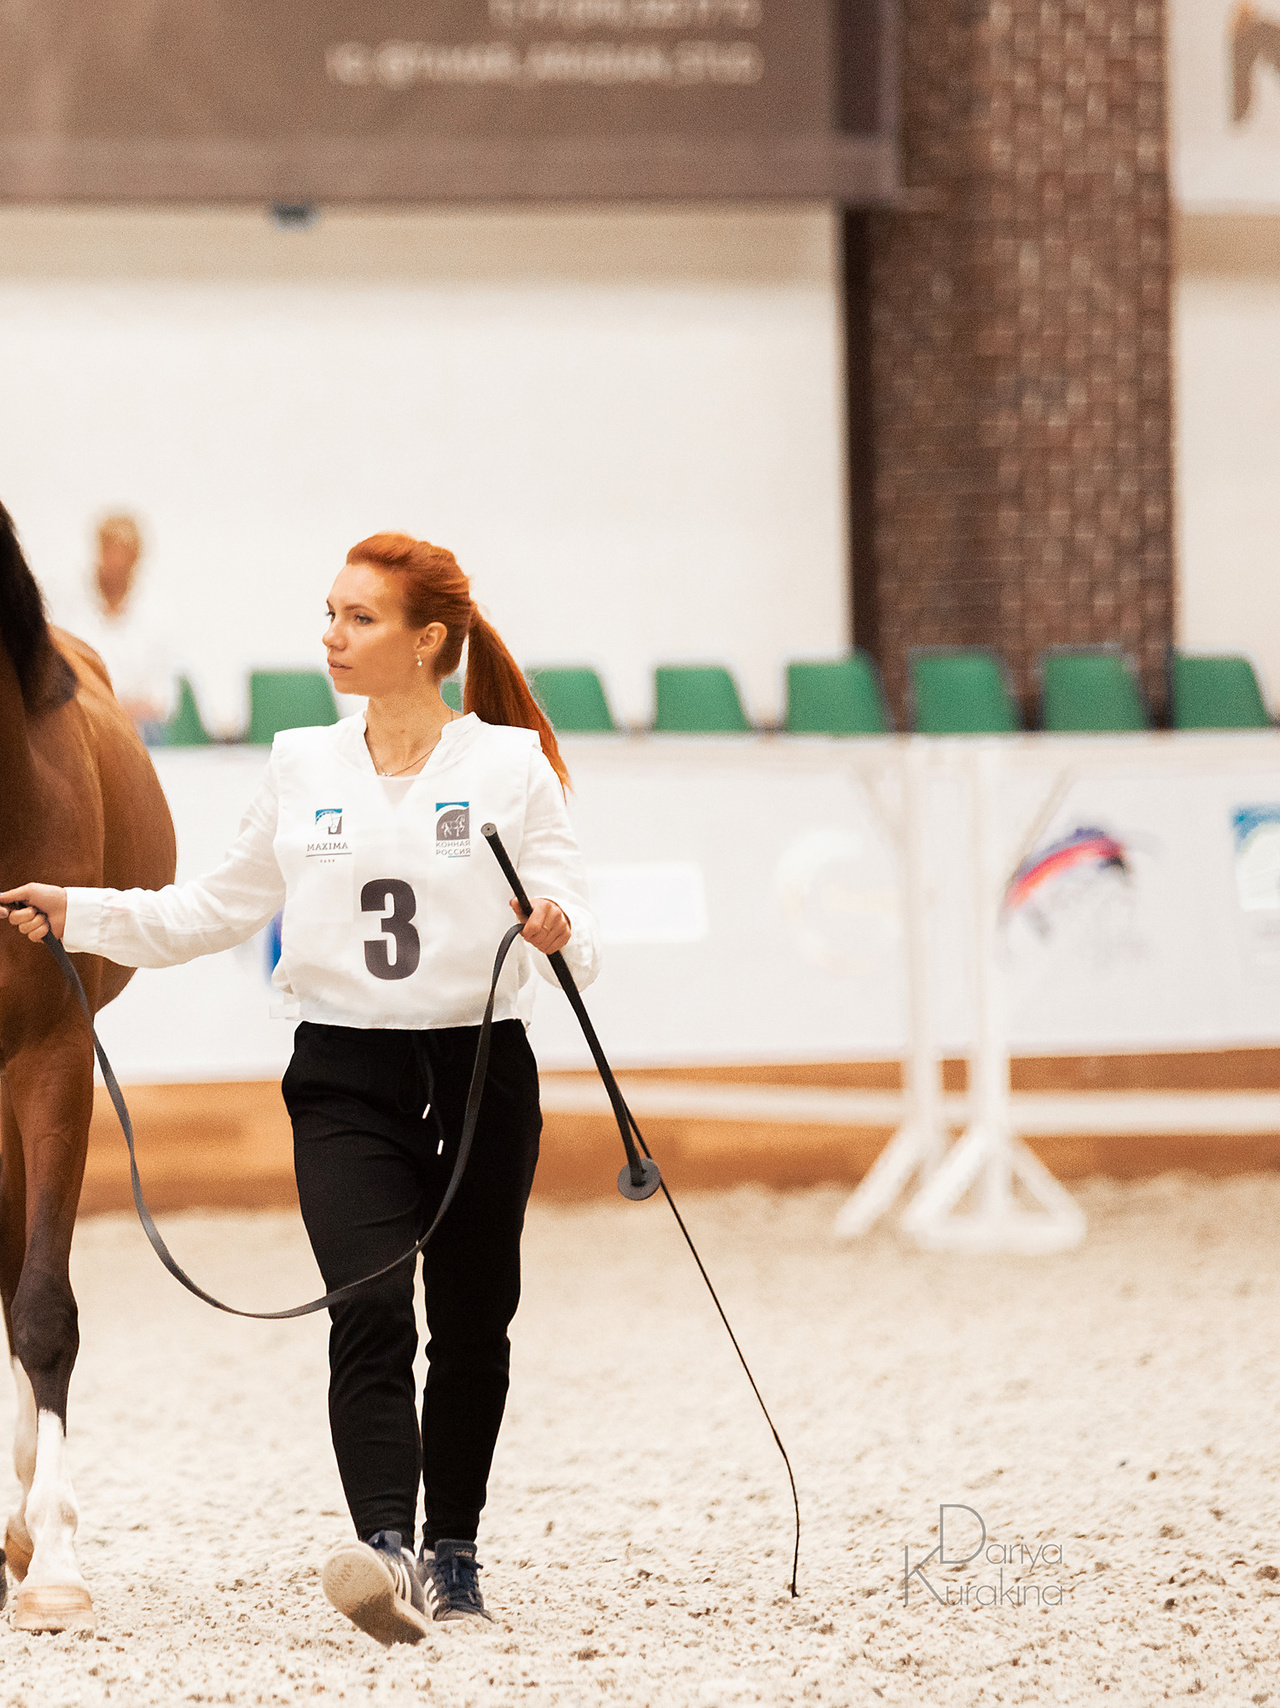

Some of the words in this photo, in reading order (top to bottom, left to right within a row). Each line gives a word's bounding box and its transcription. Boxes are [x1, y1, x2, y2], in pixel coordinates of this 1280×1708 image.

[306, 842, 349, 851] MAXIMA
[436, 840, 470, 848] КОННАЯ
[436, 848, 470, 856] РОССИЯ
[360, 878, 421, 981] 3
